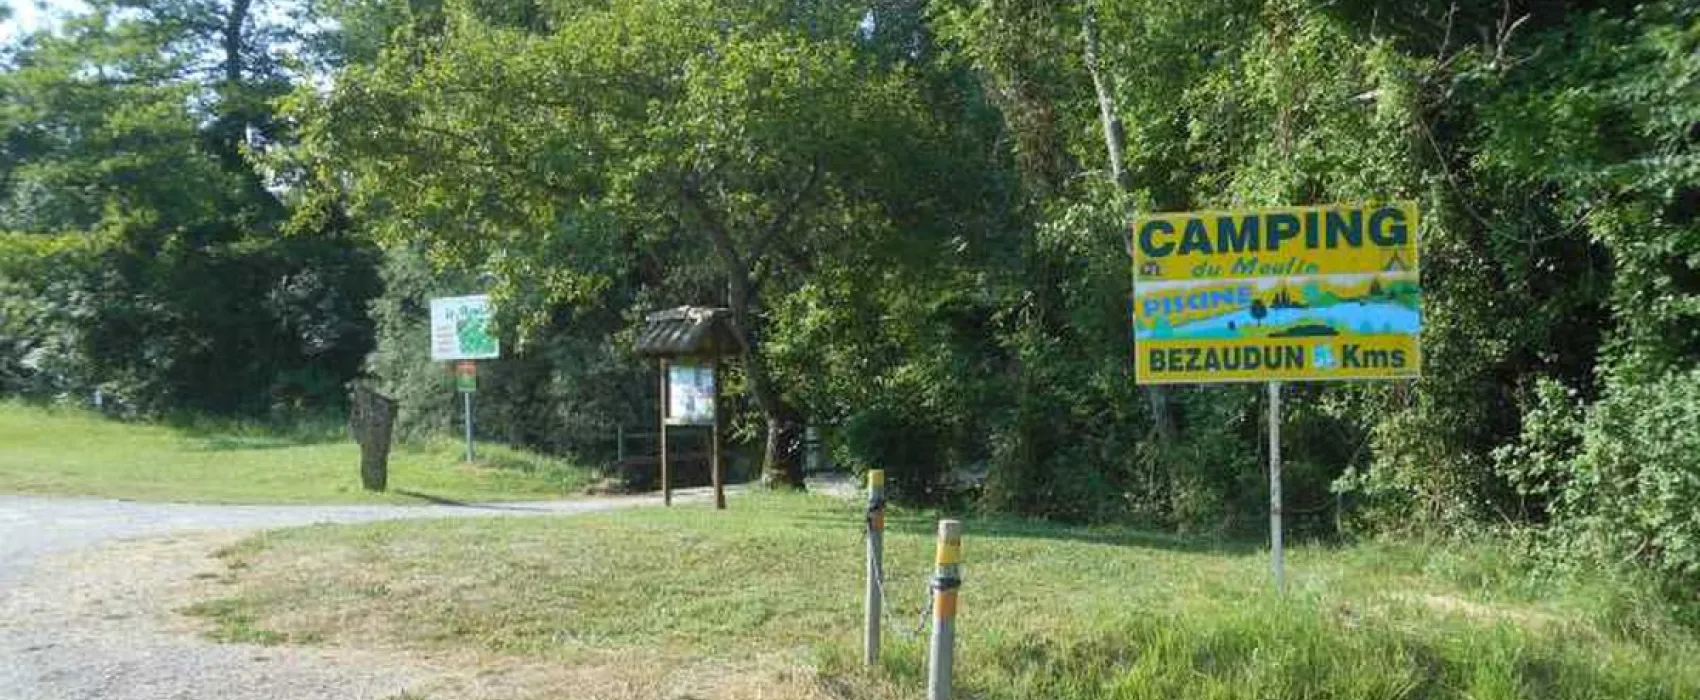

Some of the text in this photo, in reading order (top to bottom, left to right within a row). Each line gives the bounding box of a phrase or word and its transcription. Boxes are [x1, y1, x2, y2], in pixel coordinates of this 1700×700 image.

[1139, 206, 1407, 258] CAMPING
[1190, 262, 1223, 278] du
[1143, 286, 1253, 317] PISCINE
[1149, 345, 1304, 372] BEZAUDUN
[1342, 344, 1406, 369] Kms
